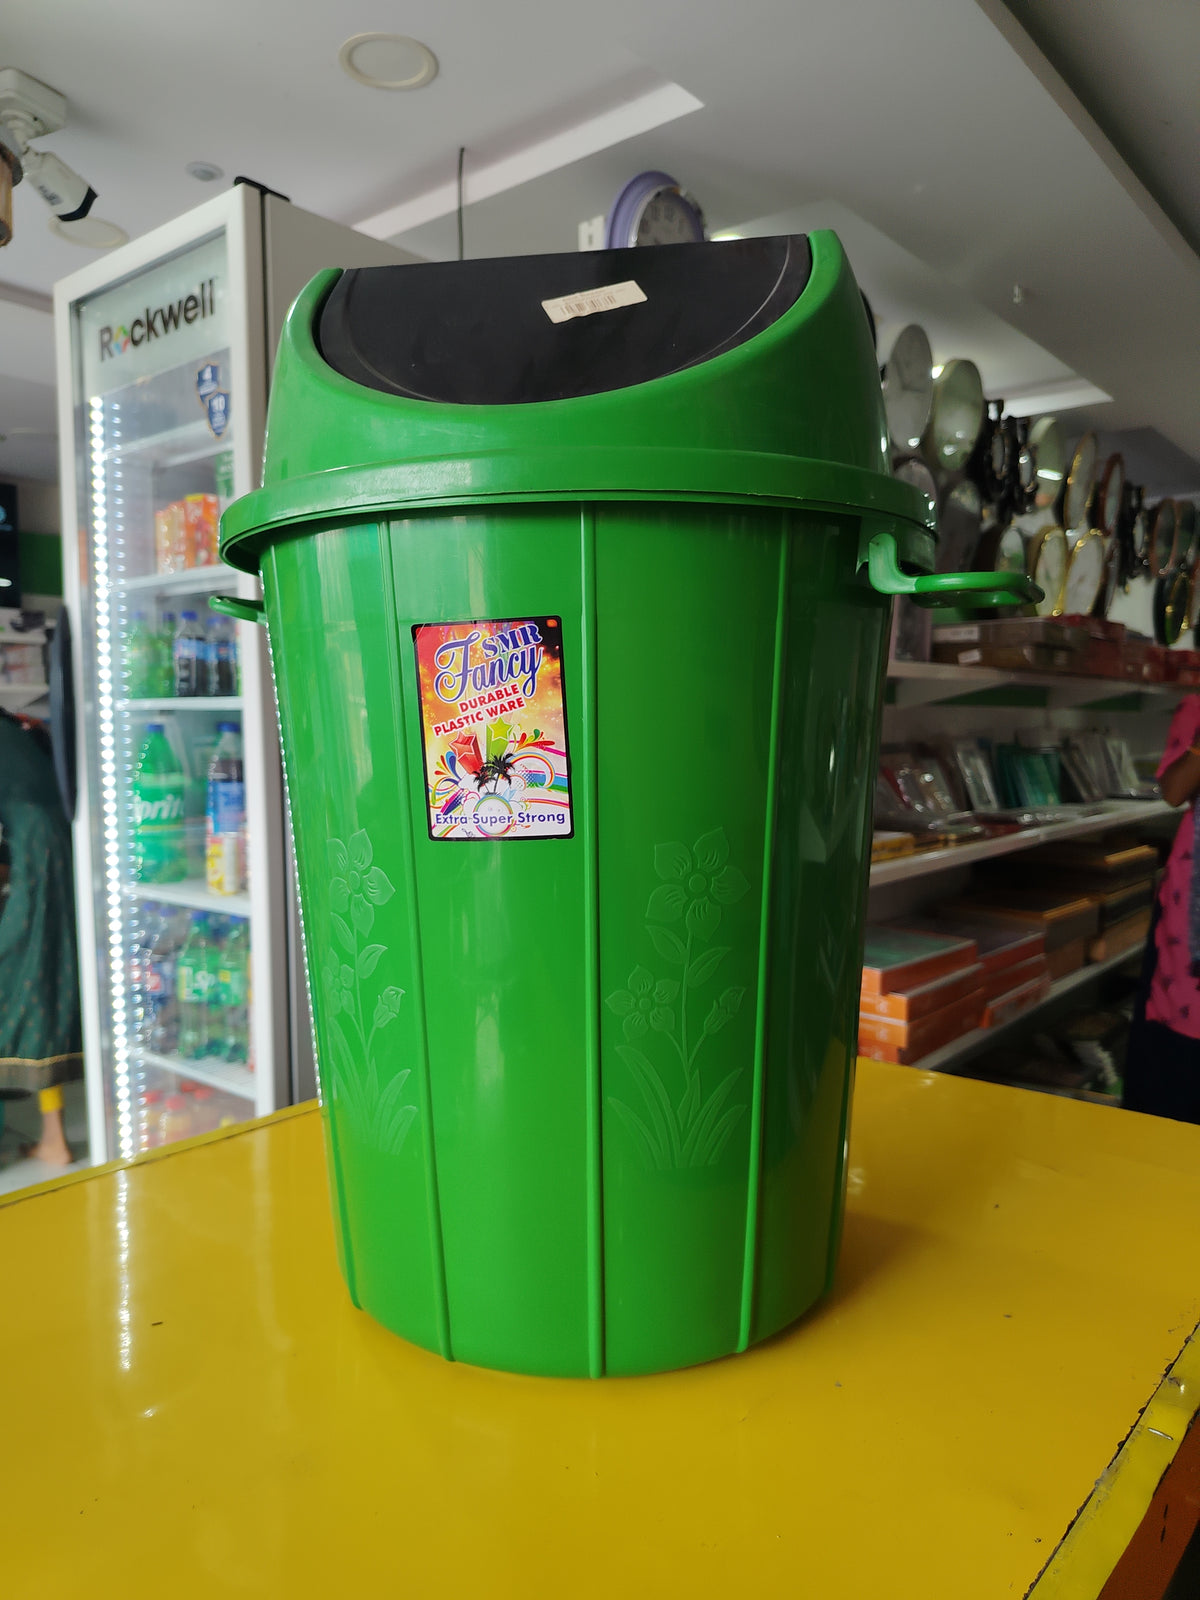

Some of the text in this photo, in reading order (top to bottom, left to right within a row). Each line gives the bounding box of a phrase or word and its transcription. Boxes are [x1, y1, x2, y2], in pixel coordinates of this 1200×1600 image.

[100, 279, 215, 362] Rockwell
[482, 625, 542, 658] SMR
[434, 633, 543, 702] Fancy
[434, 697, 525, 736] PLASTIC WARE
[459, 684, 520, 713] DURABLE
[435, 812, 565, 826] Extra Super Strong
